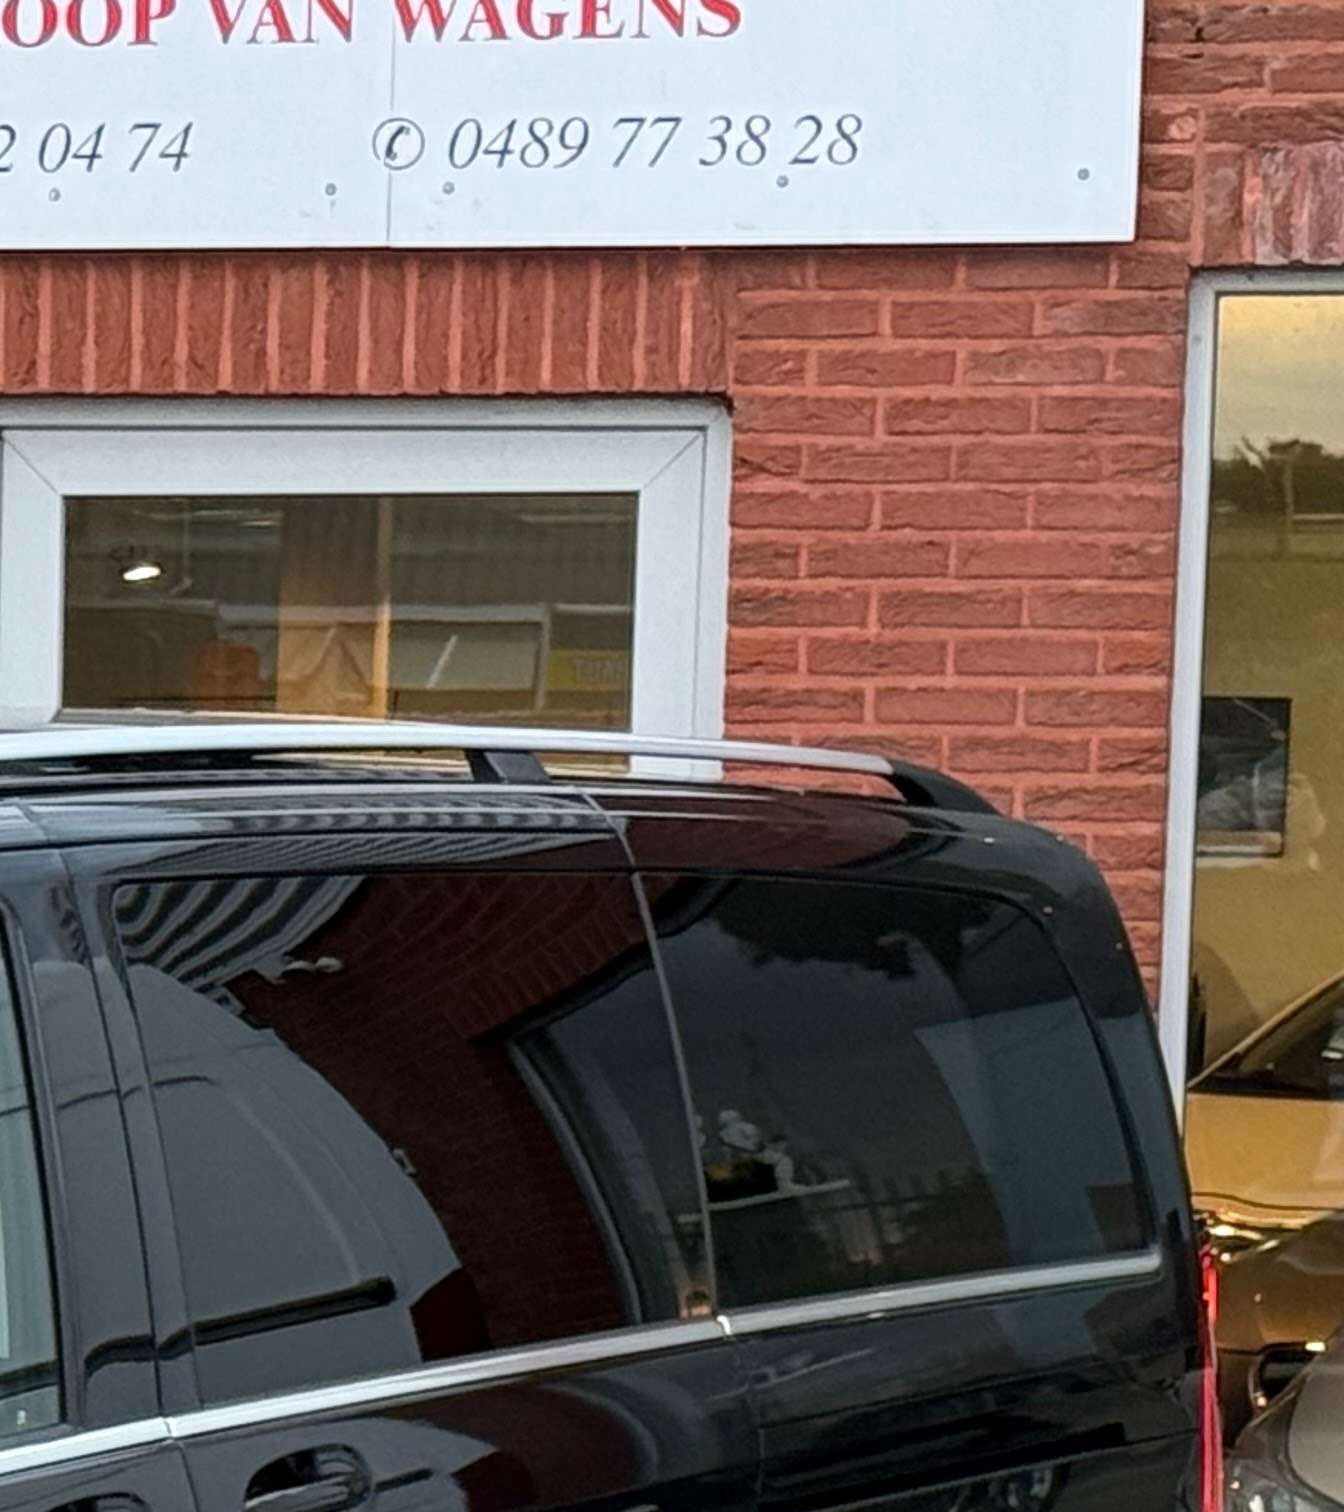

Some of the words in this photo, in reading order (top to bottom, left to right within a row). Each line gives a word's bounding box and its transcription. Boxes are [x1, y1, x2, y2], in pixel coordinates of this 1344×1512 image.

[205, 0, 355, 45] VAN
[388, 0, 744, 43] WAGENS
[37, 122, 106, 173] 04
[128, 121, 193, 172] 74
[447, 116, 590, 169] 0489
[611, 116, 682, 168] 77
[698, 116, 771, 167] 38
[787, 114, 862, 167] 28
